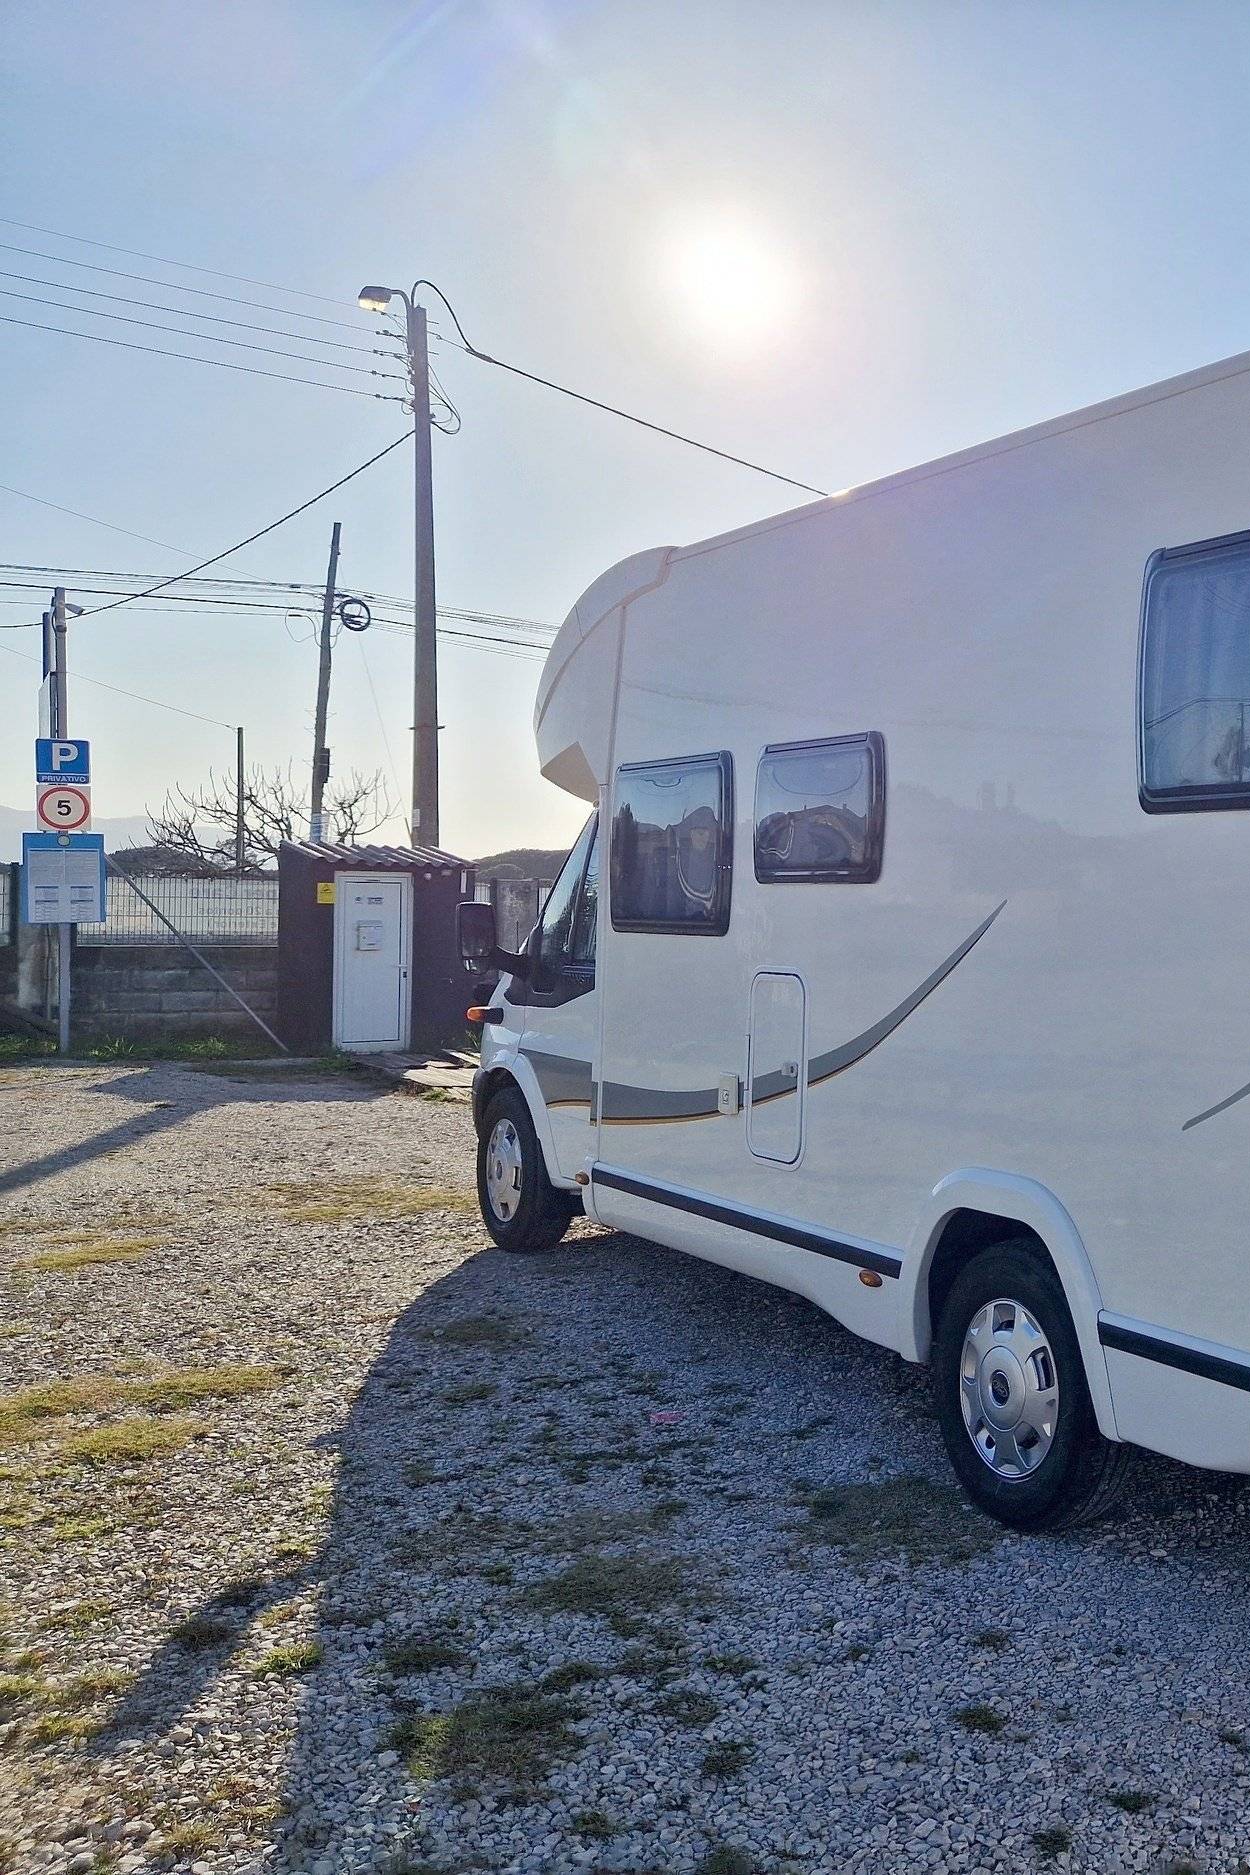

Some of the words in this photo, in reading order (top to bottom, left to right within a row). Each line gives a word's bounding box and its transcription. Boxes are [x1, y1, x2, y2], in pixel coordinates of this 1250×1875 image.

[52, 742, 78, 770] P
[41, 775, 86, 783] PRIVATIVO
[57, 800, 72, 816] 5
